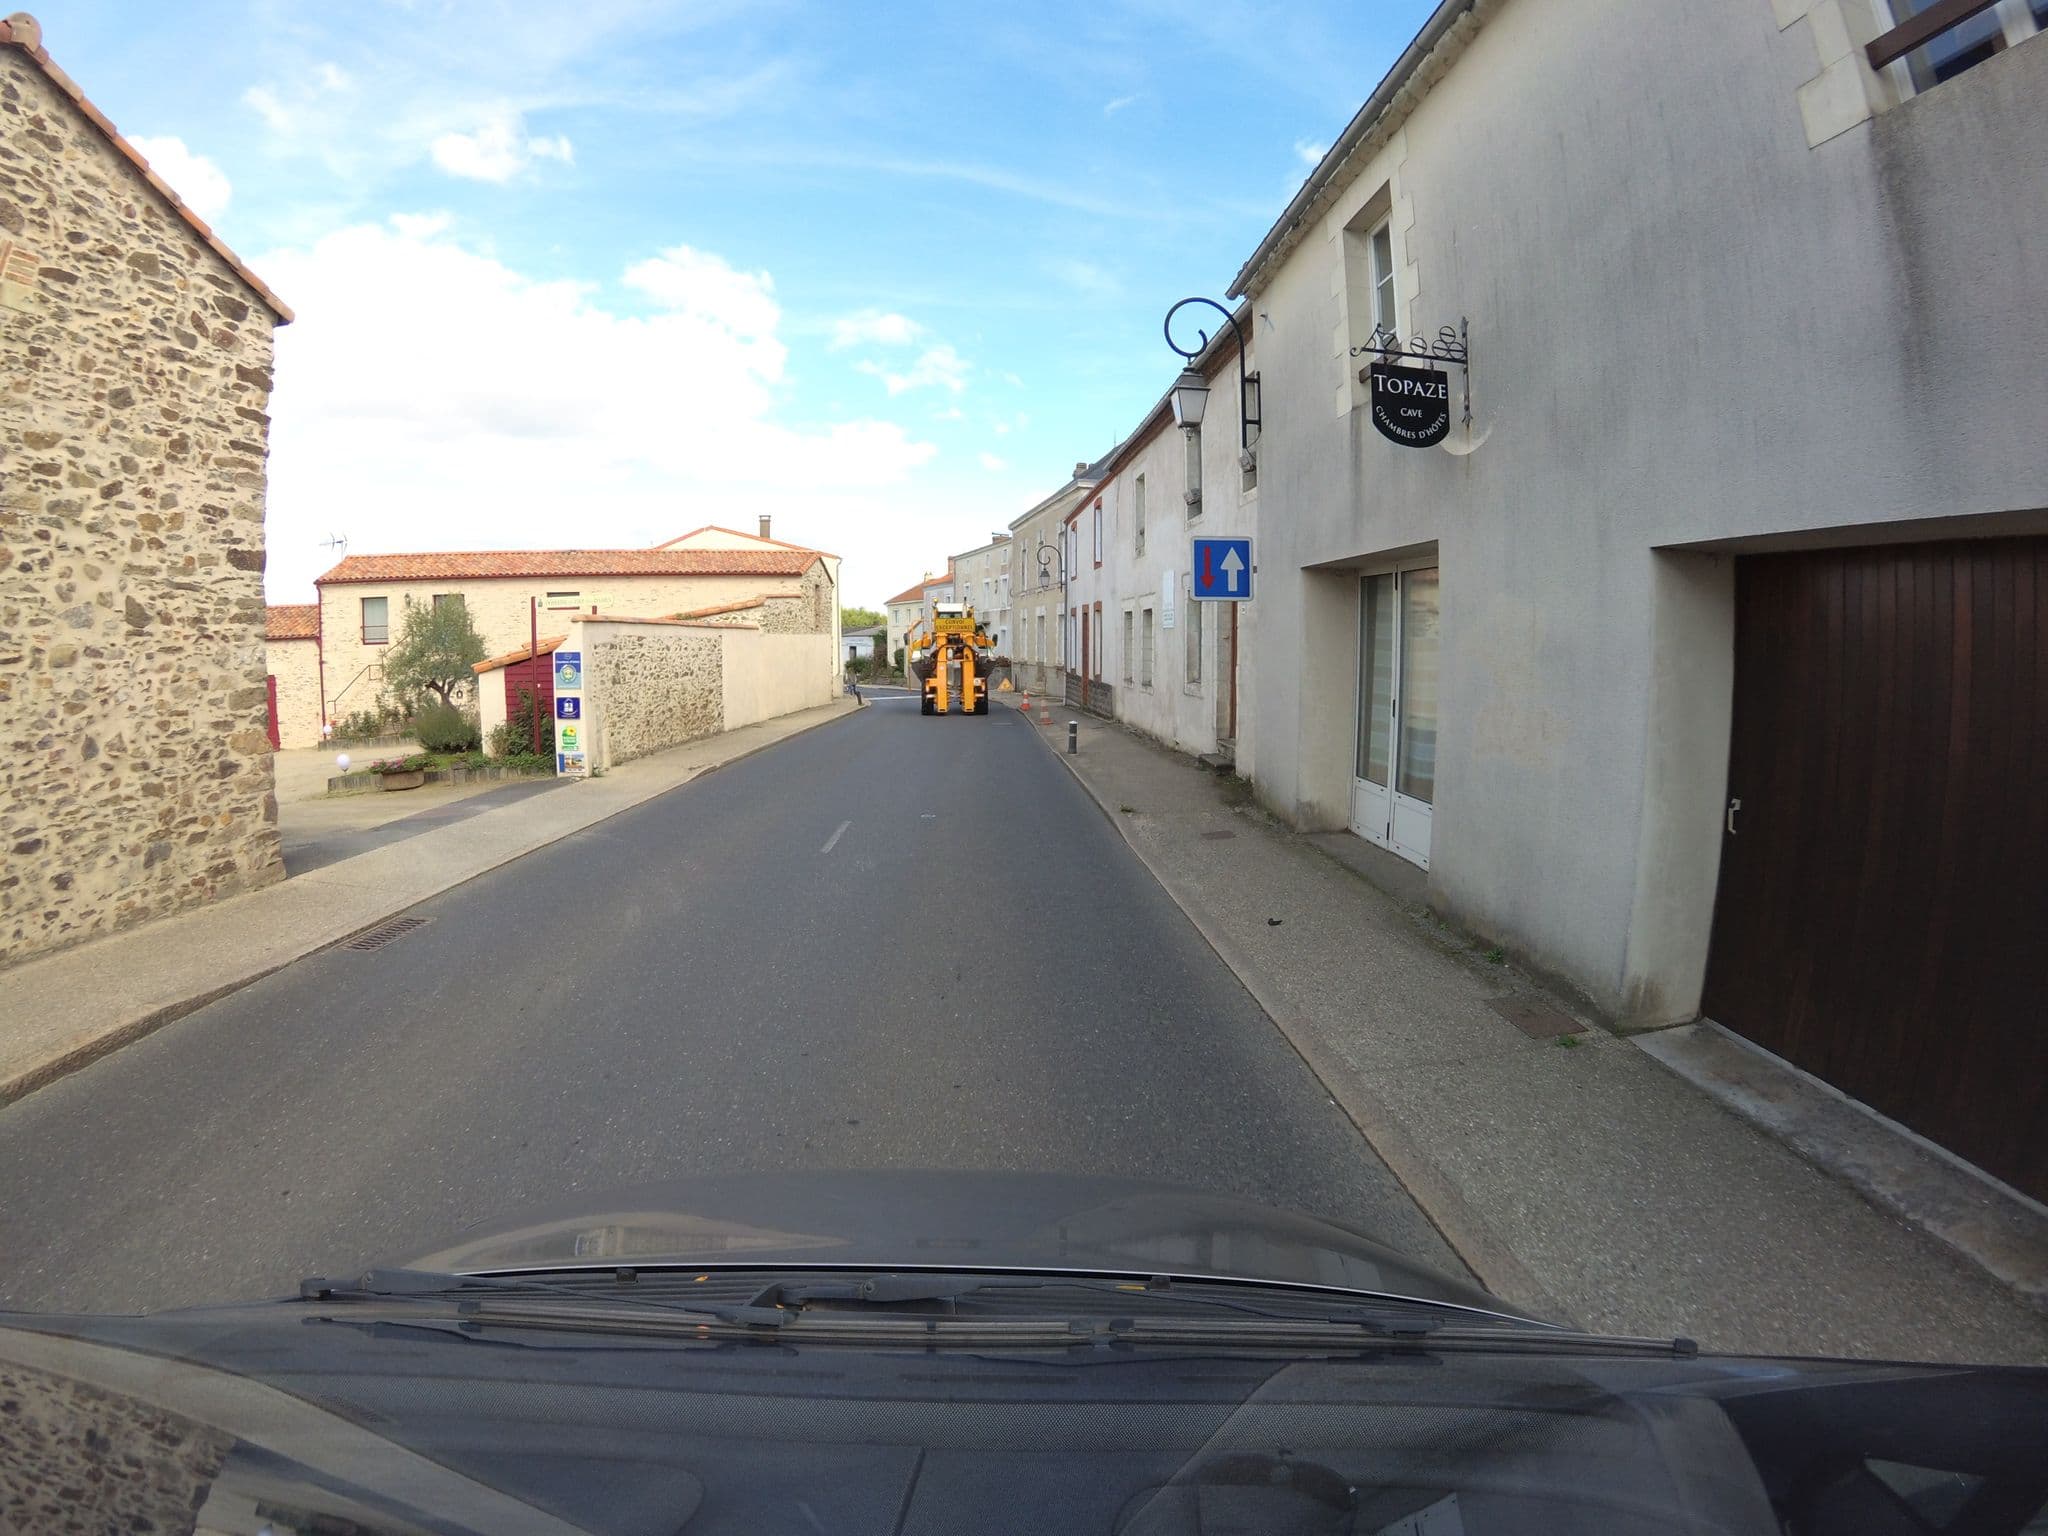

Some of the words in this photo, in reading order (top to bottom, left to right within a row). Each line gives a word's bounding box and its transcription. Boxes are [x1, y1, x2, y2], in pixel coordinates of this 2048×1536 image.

[1373, 374, 1447, 399] TOPAZE
[1375, 405, 1416, 439] CHAMBRES
[1400, 407, 1423, 418] CAVE
